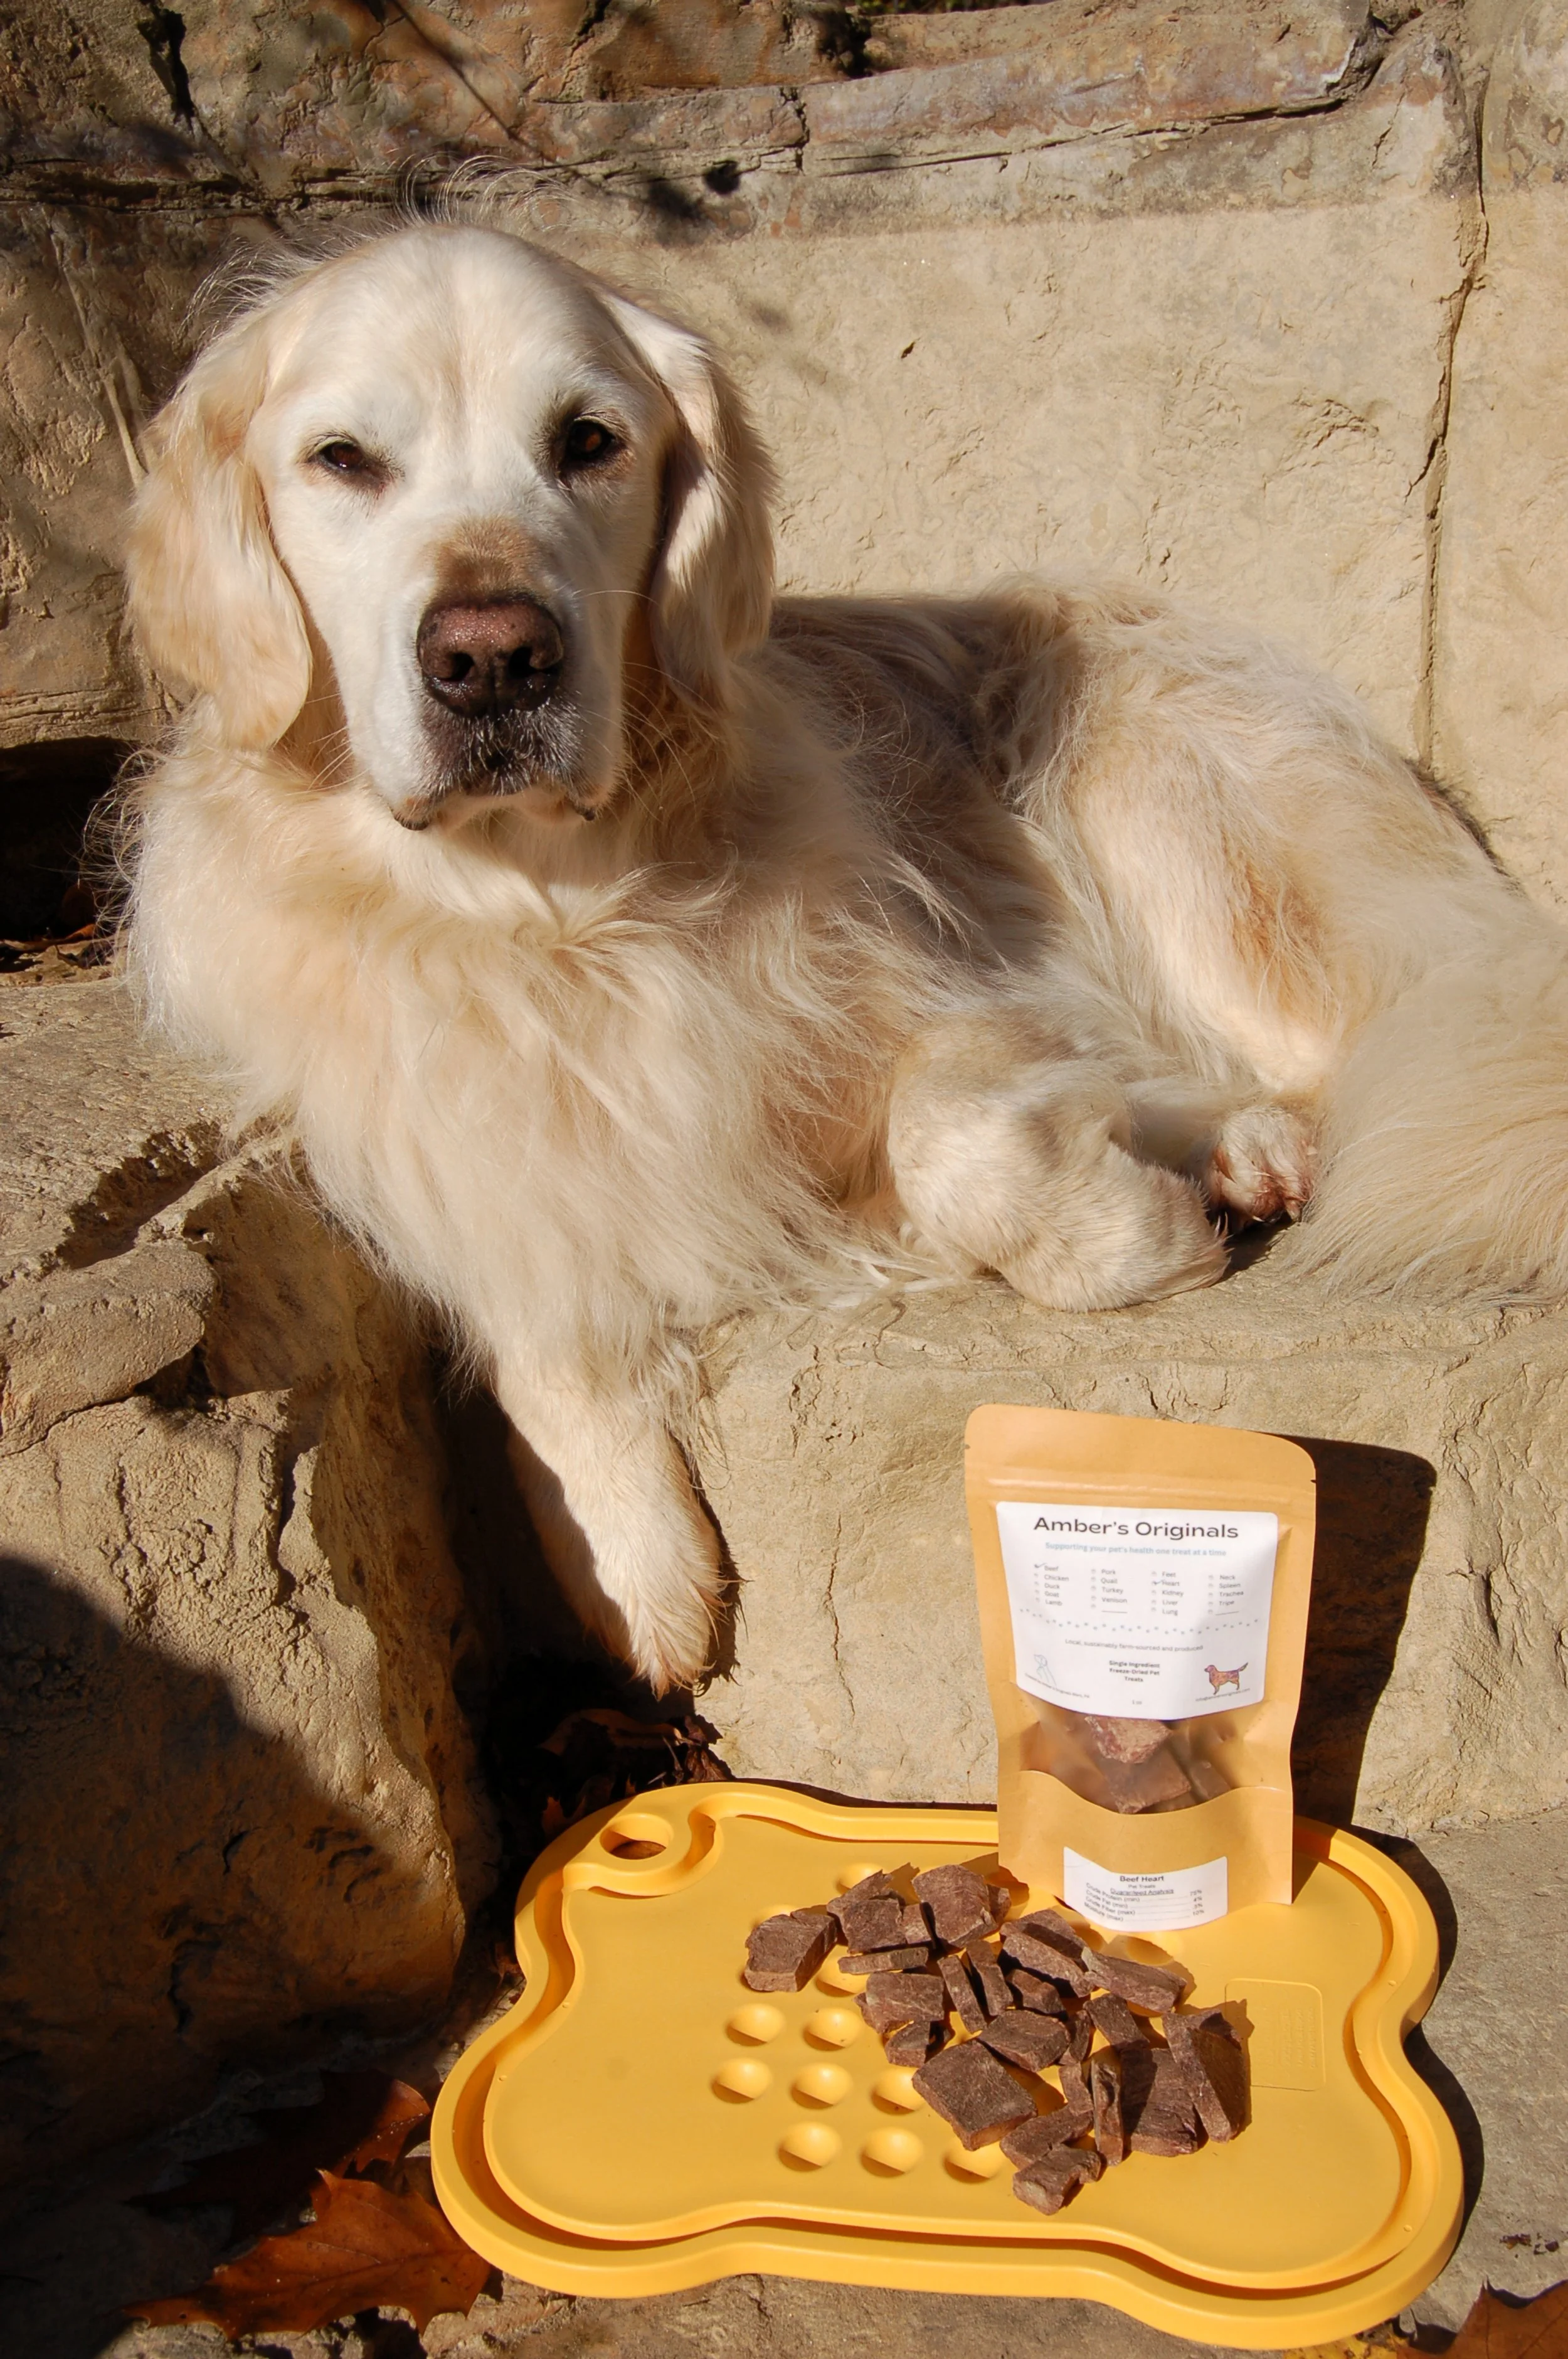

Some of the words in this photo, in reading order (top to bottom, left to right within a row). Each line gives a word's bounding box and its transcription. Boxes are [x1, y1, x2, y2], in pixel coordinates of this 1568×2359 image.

[1034, 1517, 1129, 1535] Amber's
[1136, 1522, 1239, 1541] Originals
[1045, 1542, 1088, 1553] Supporting
[1089, 1545, 1106, 1553] your
[1108, 1545, 1128, 1553] pet's
[1084, 1641, 1118, 1649] sustainably
[1109, 1668, 1148, 1676] Freeze-Dried
